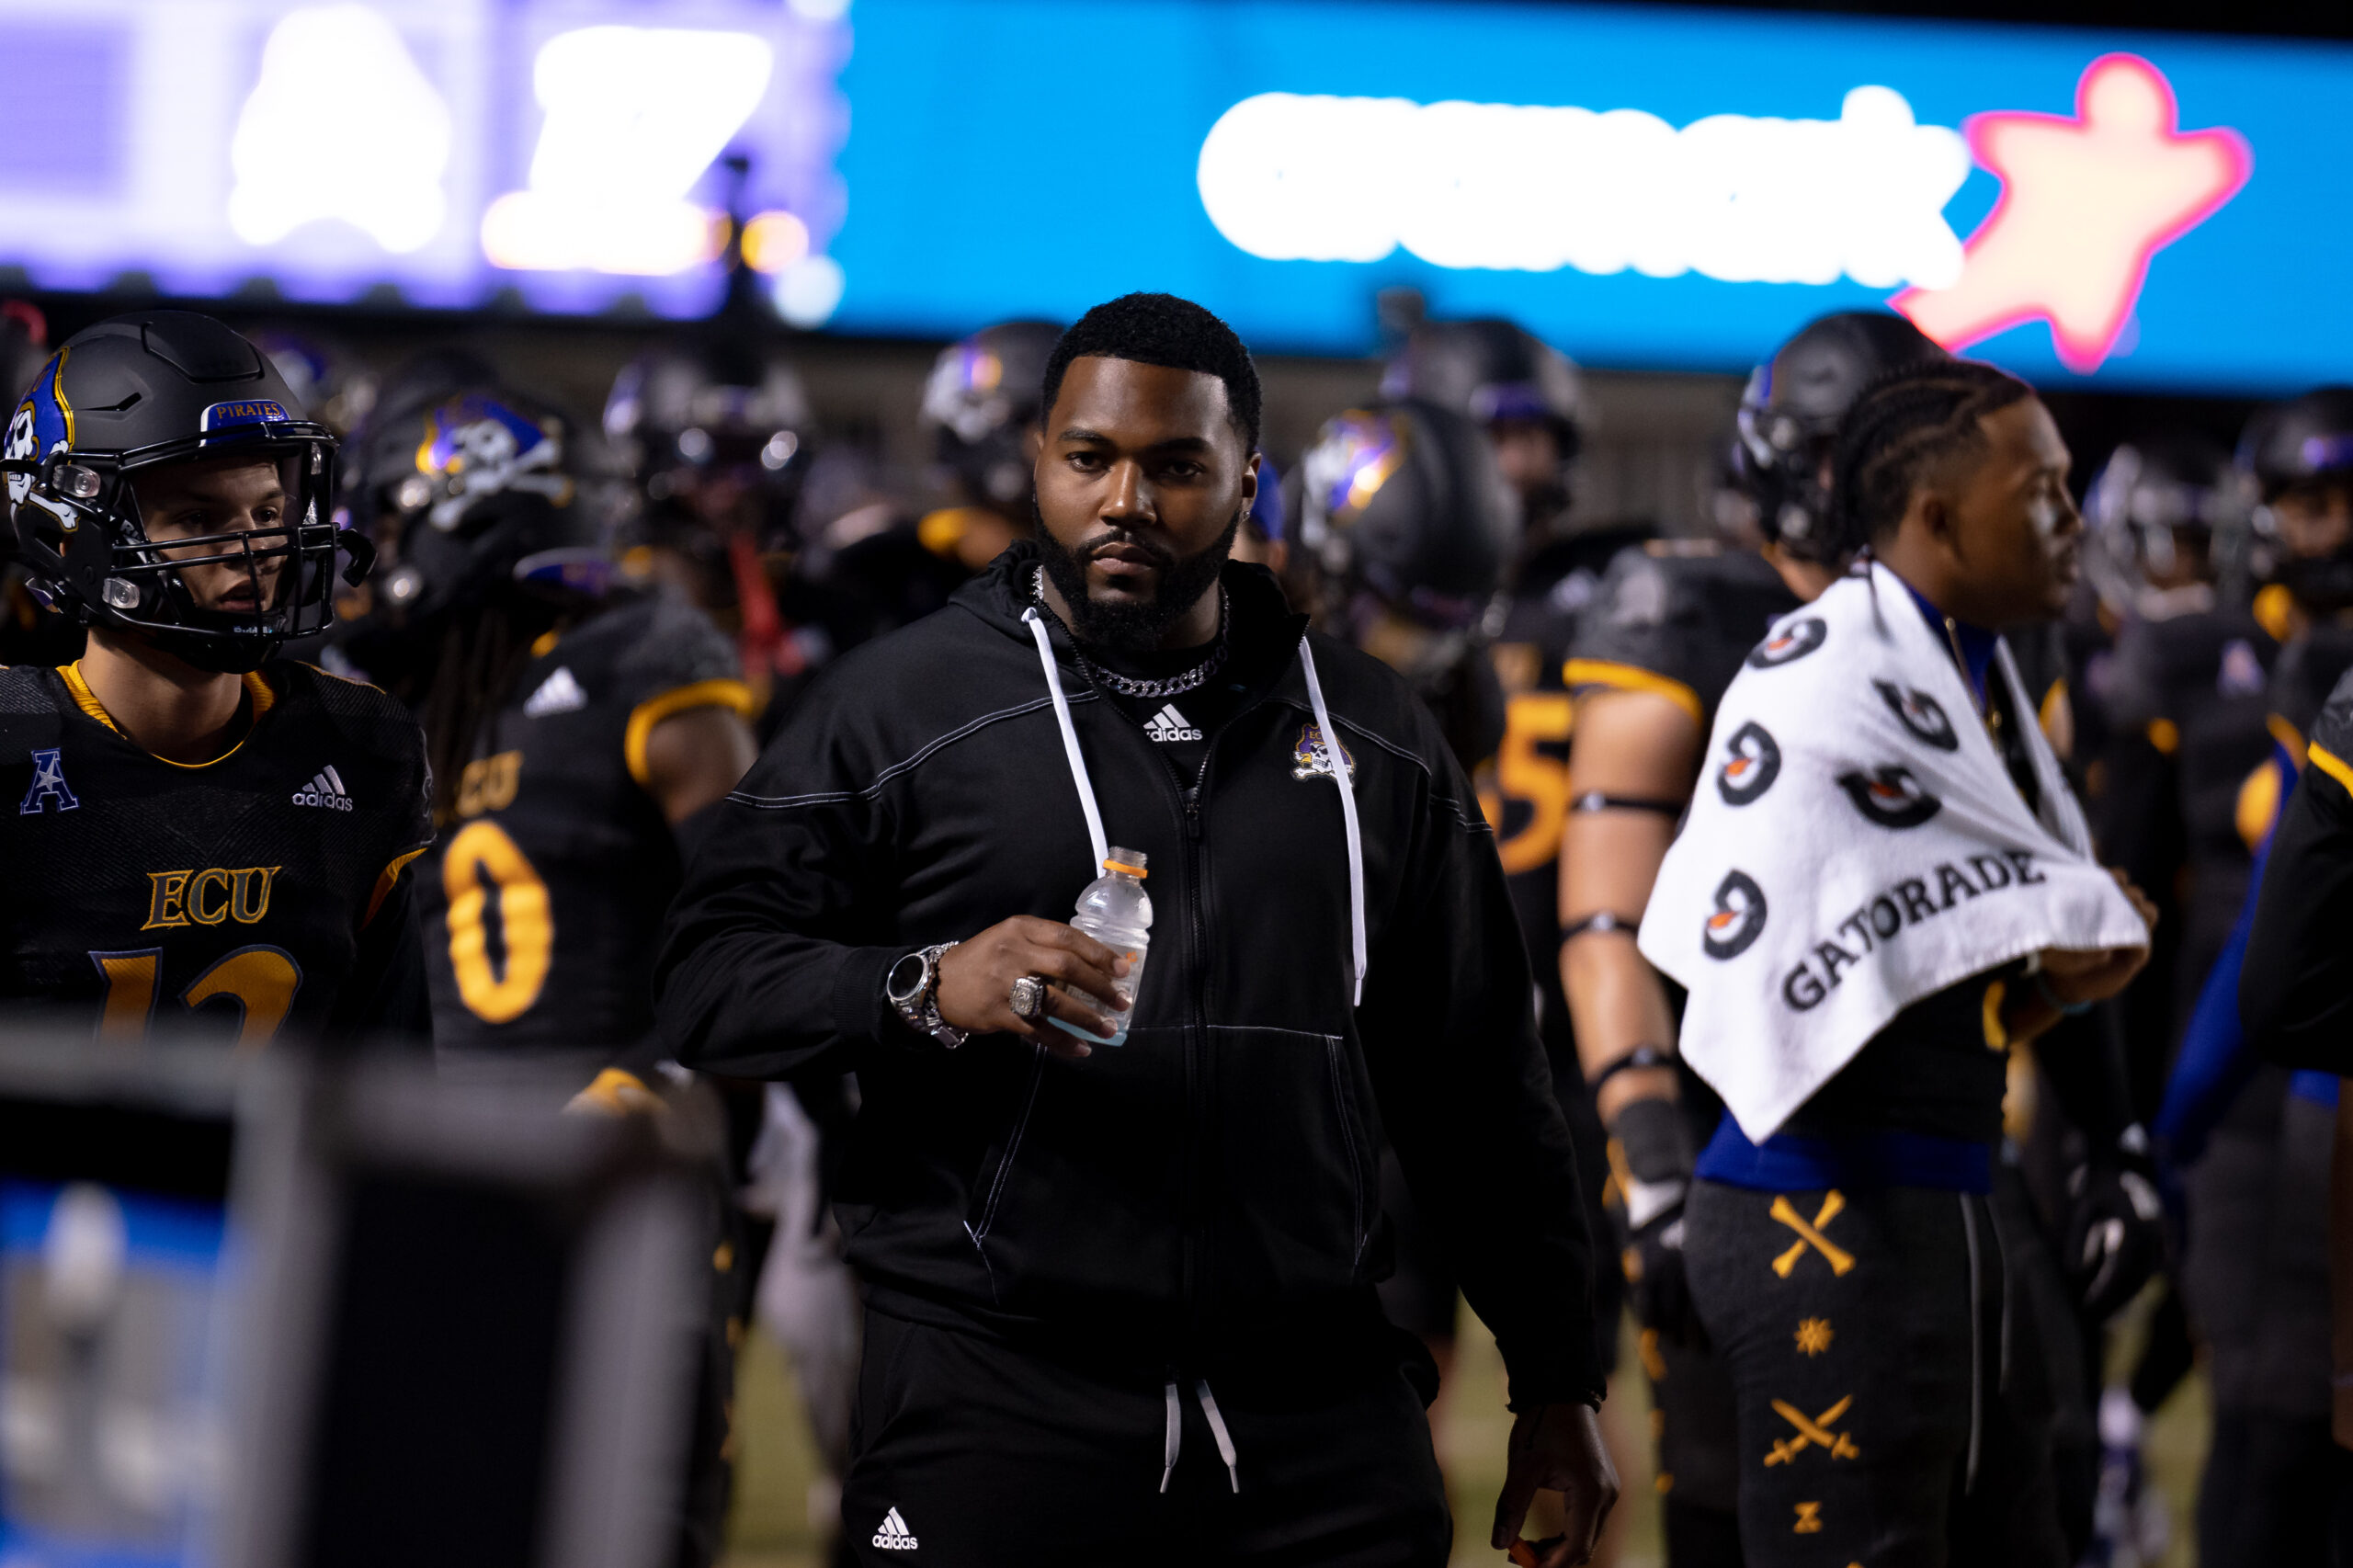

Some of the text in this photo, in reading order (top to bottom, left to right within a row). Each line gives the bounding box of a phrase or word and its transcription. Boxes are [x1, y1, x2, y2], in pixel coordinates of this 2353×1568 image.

[216, 403, 280, 420] PIRATES
[1146, 727, 1203, 742] didas
[291, 790, 354, 812] adidas
[139, 865, 283, 932] ECU
[440, 818, 556, 1025] 0
[1780, 849, 2048, 1012] GATORADE
[871, 1533, 919, 1551] adidas
